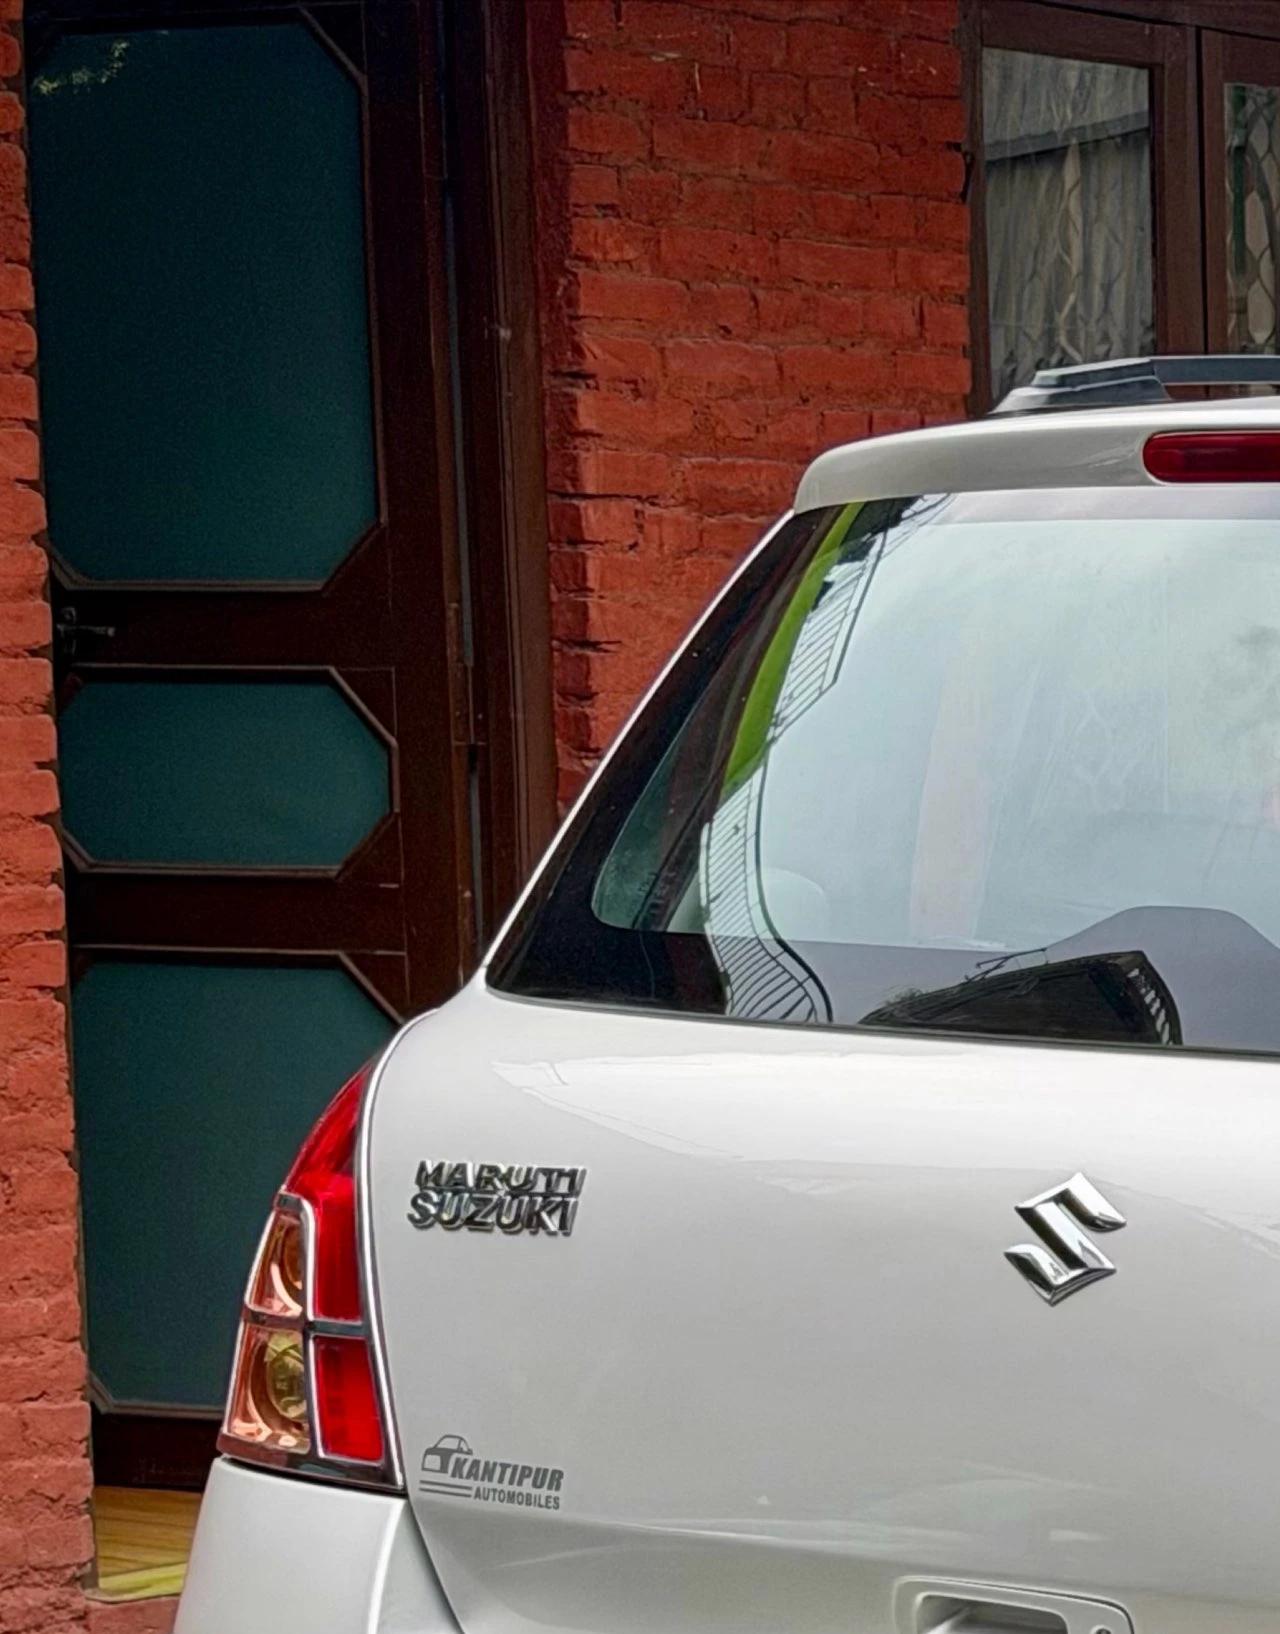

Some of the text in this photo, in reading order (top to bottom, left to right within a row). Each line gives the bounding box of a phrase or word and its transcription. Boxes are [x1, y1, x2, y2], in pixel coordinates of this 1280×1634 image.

[415, 1160, 587, 1196] MARUTI
[407, 1190, 579, 1236] SUZUKI
[451, 1456, 564, 1492] KANTIPUR
[473, 1486, 561, 1511] AUTOMOBILES
